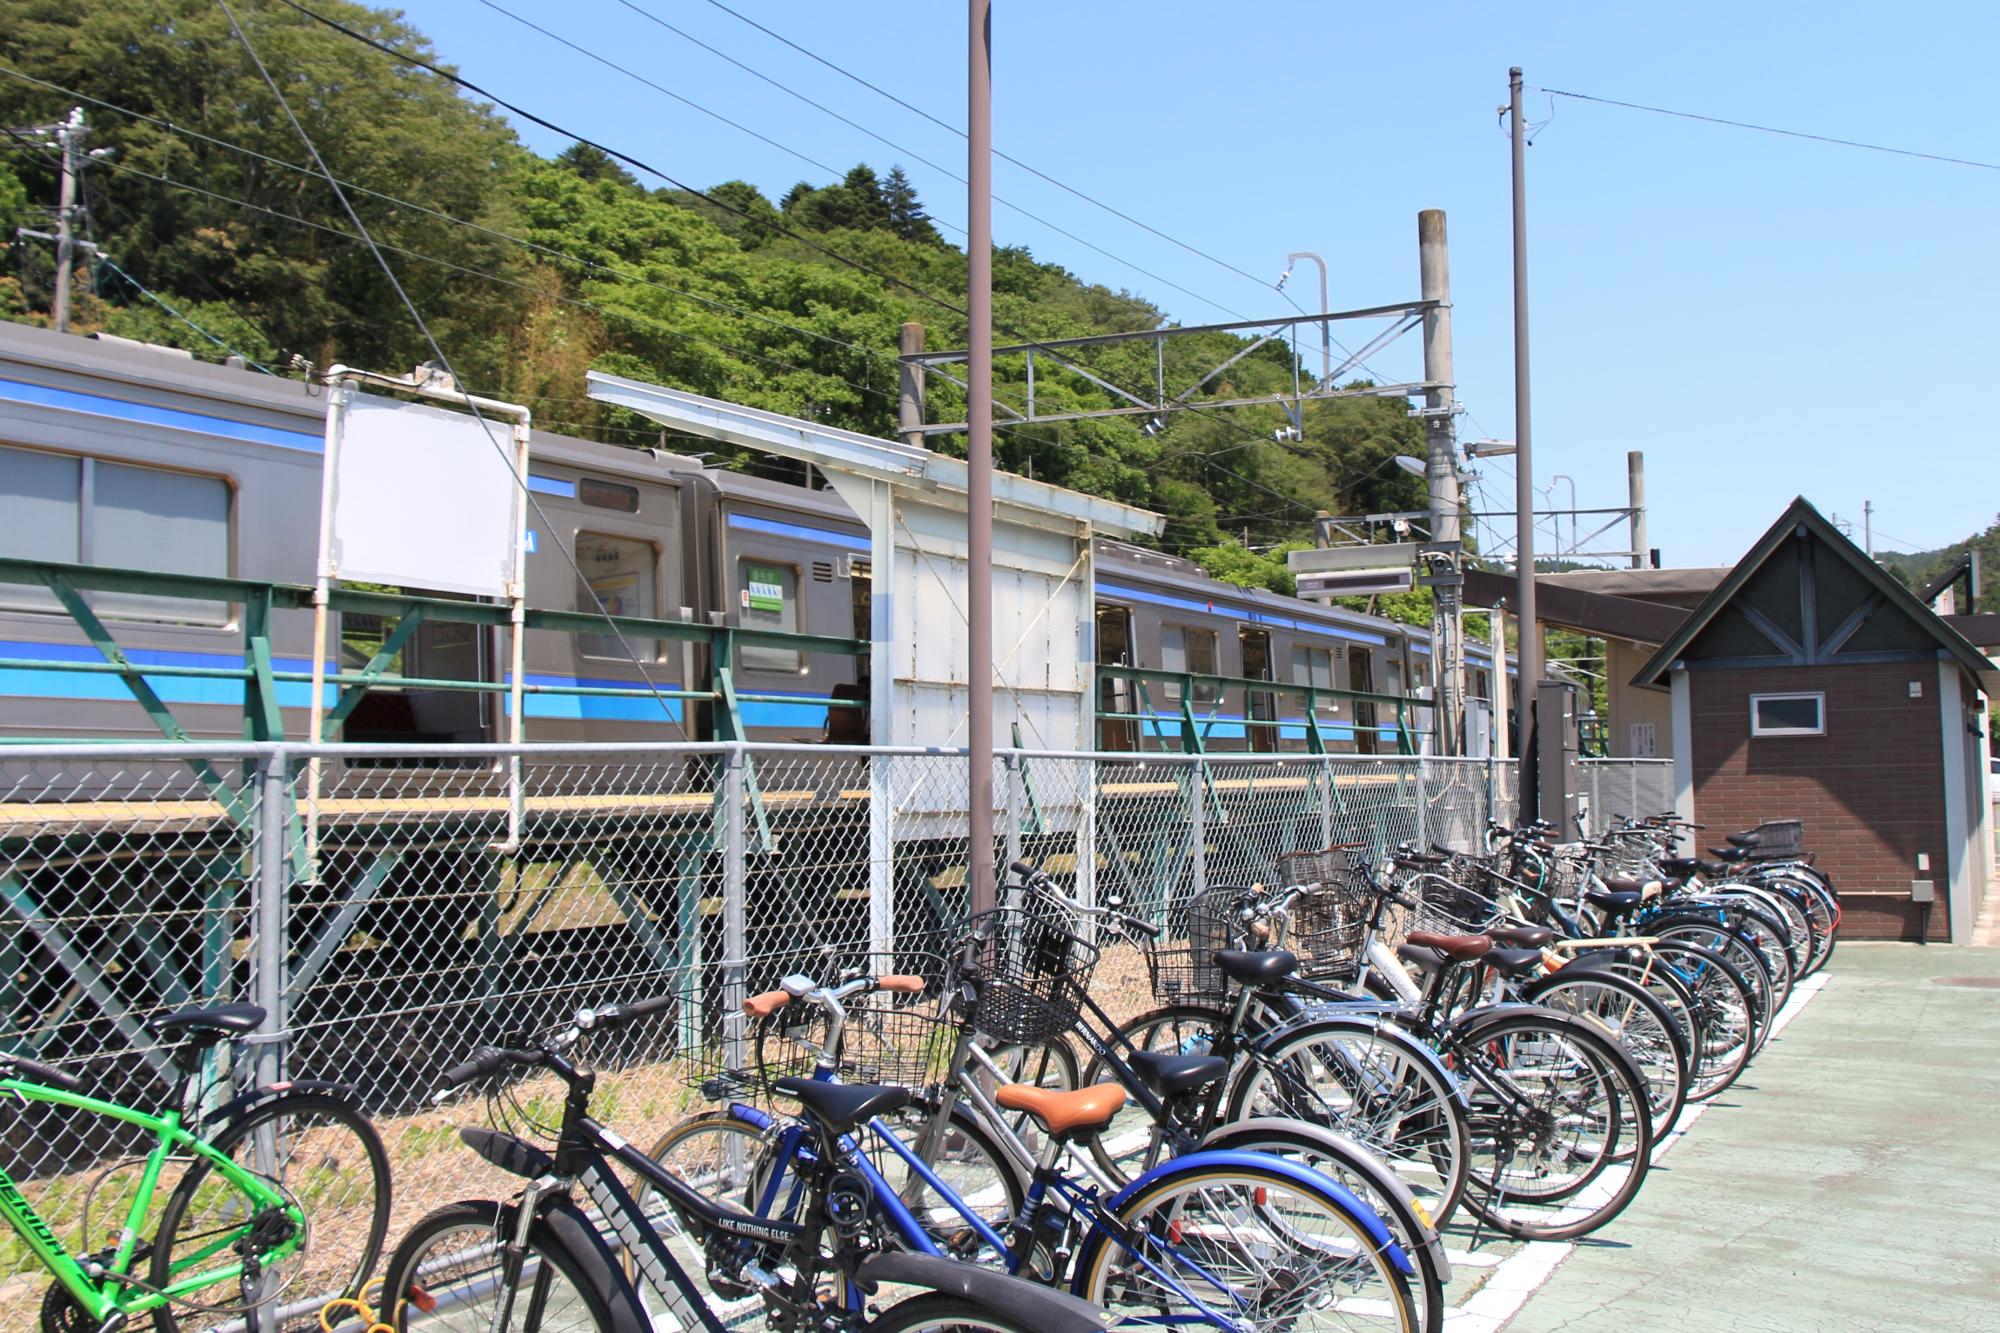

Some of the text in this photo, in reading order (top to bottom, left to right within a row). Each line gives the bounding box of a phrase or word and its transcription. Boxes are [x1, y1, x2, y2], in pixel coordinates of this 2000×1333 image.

[1074, 1020, 1106, 1055] BERNARDO
[718, 1217, 735, 1230] LIKE
[736, 1221, 769, 1237] NOTHING
